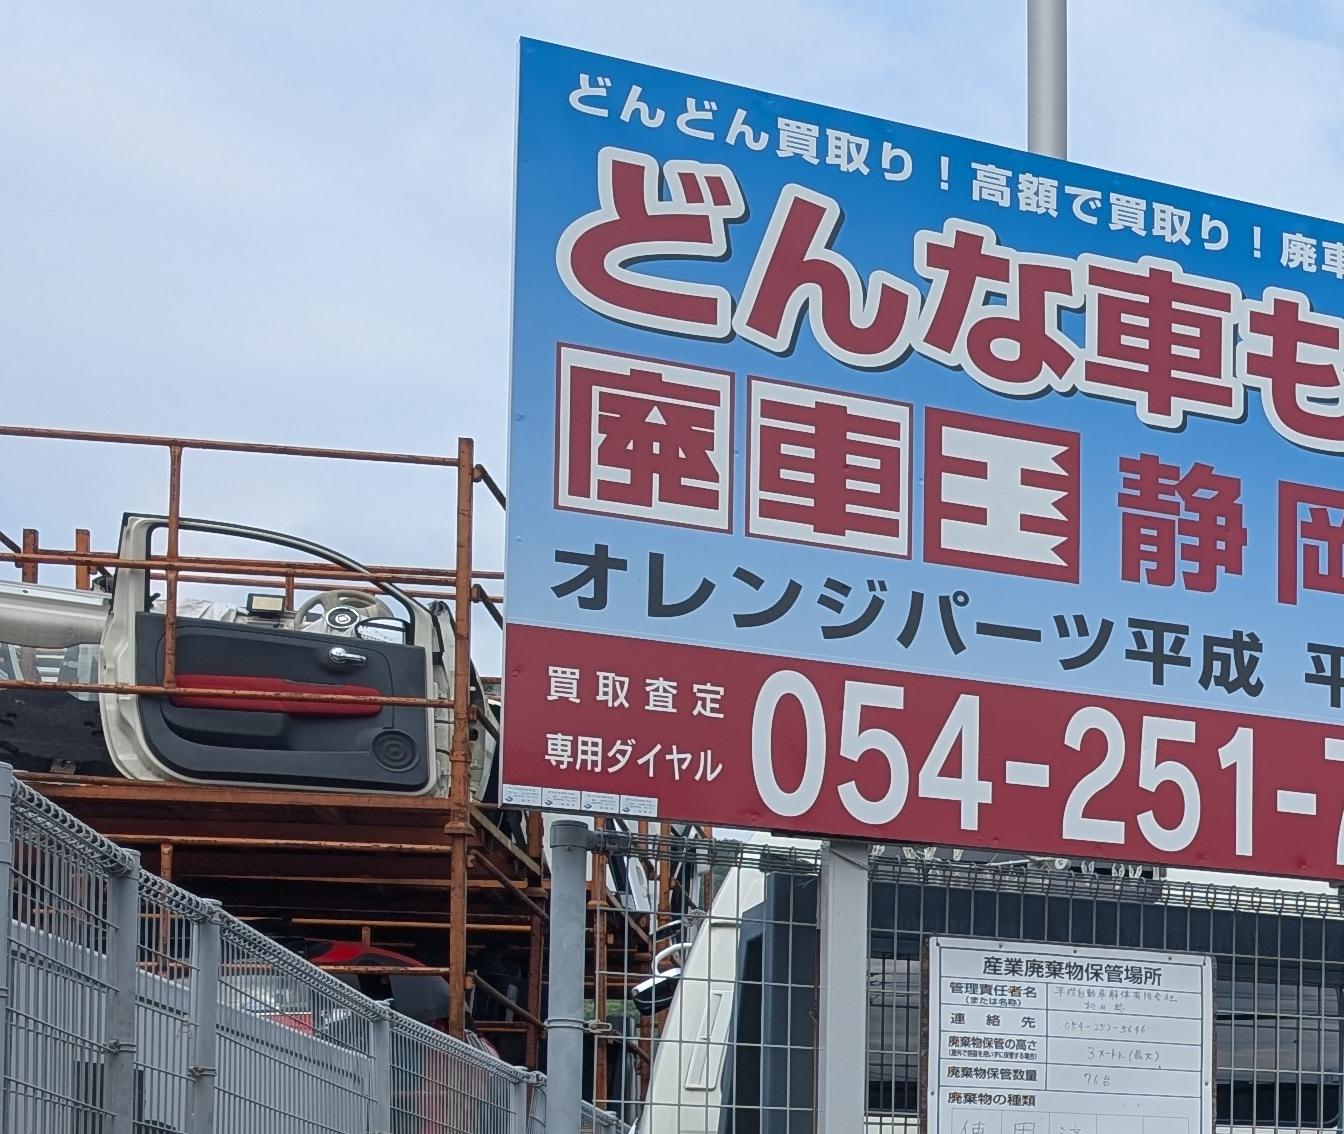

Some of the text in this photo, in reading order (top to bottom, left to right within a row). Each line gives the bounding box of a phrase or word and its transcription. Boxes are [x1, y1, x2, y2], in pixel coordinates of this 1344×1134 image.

[550, 544, 1265, 696] オレンジパーツ平成
[546, 666, 727, 719] 買取査定
[544, 732, 723, 785] 専用ダイヤル
[982, 956, 1163, 987] 産業廃棄物保管場所
[949, 982, 1037, 999] 管理責任者名
[947, 1035, 1038, 1051] 廃棄物保管の高さ
[946, 1065, 1038, 1082] 廃棄物保管数量
[947, 1092, 1037, 1107] 廃棄物の種類
